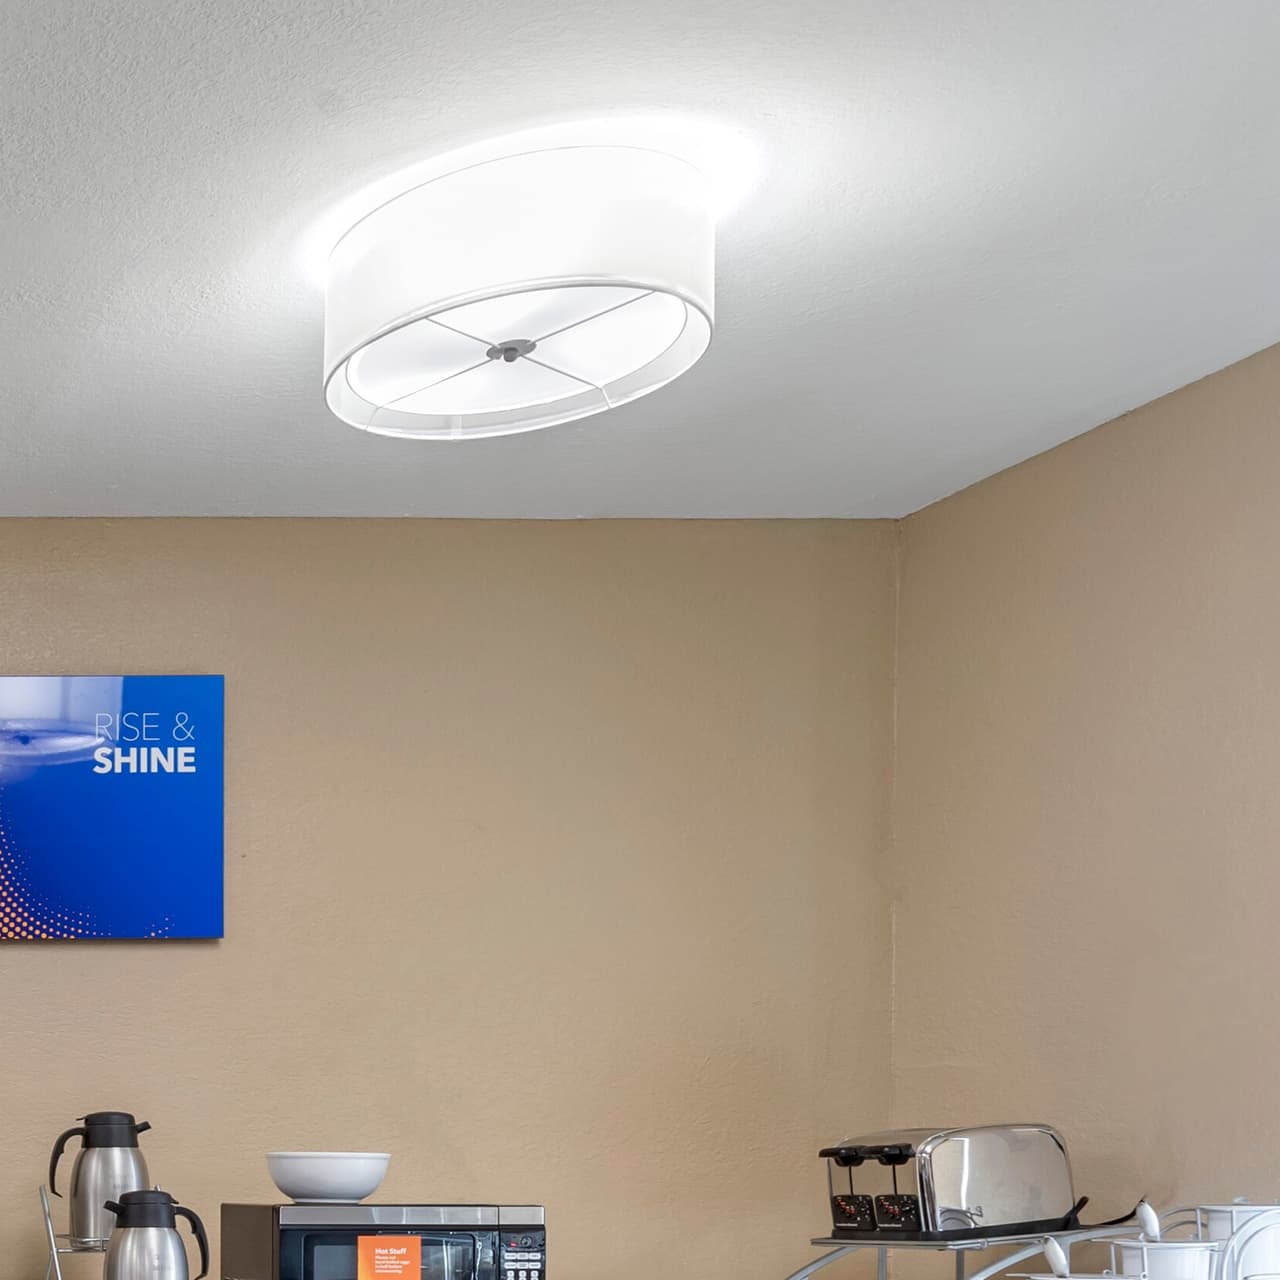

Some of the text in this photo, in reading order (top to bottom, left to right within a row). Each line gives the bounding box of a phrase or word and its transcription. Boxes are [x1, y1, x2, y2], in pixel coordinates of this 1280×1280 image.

[95, 711, 196, 741] RISE &
[93, 746, 196, 774] SHINE
[390, 1247, 408, 1255] Stuff
